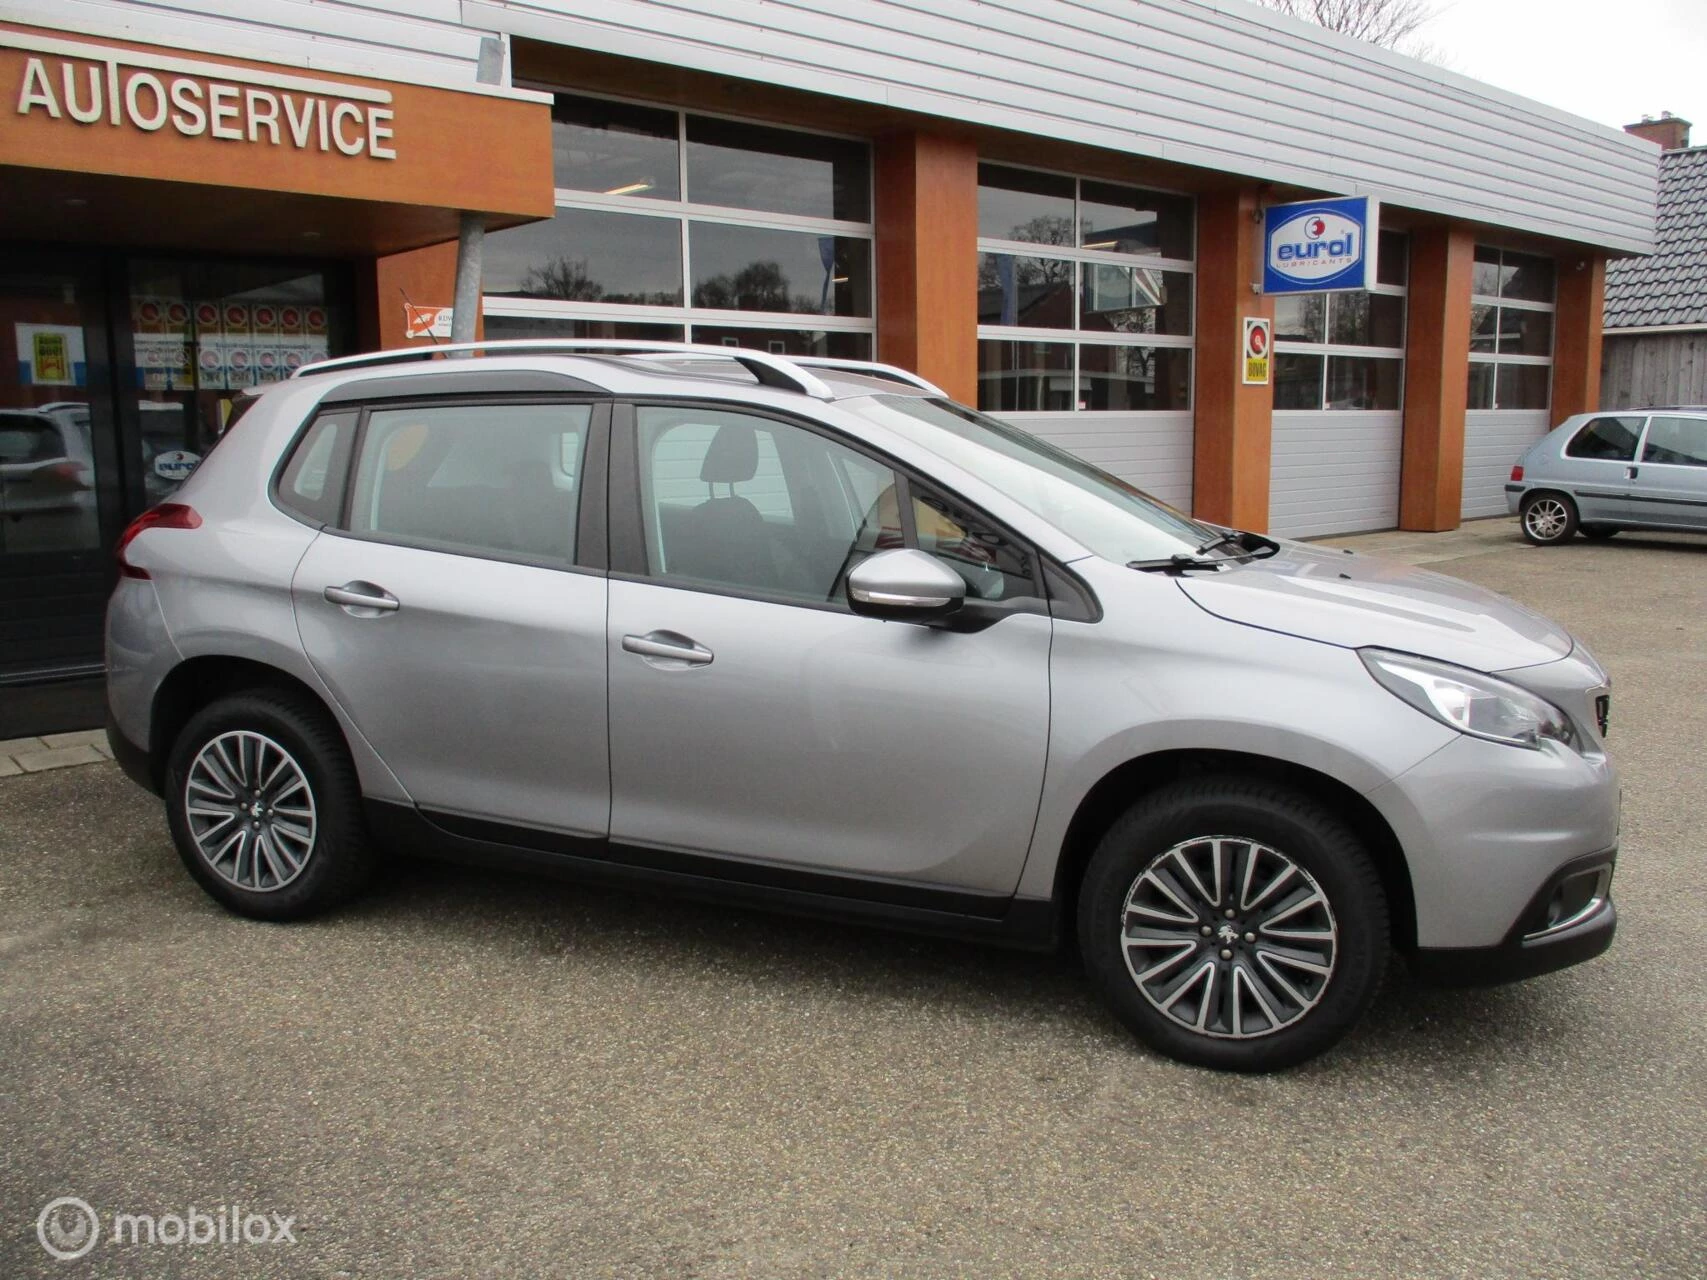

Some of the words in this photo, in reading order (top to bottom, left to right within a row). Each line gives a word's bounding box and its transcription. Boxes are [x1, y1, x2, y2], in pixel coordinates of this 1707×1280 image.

[16, 56, 397, 161] AUTOSERVICE
[1278, 233, 1352, 260] eurol
[1276, 257, 1352, 269] LUBRICANTS
